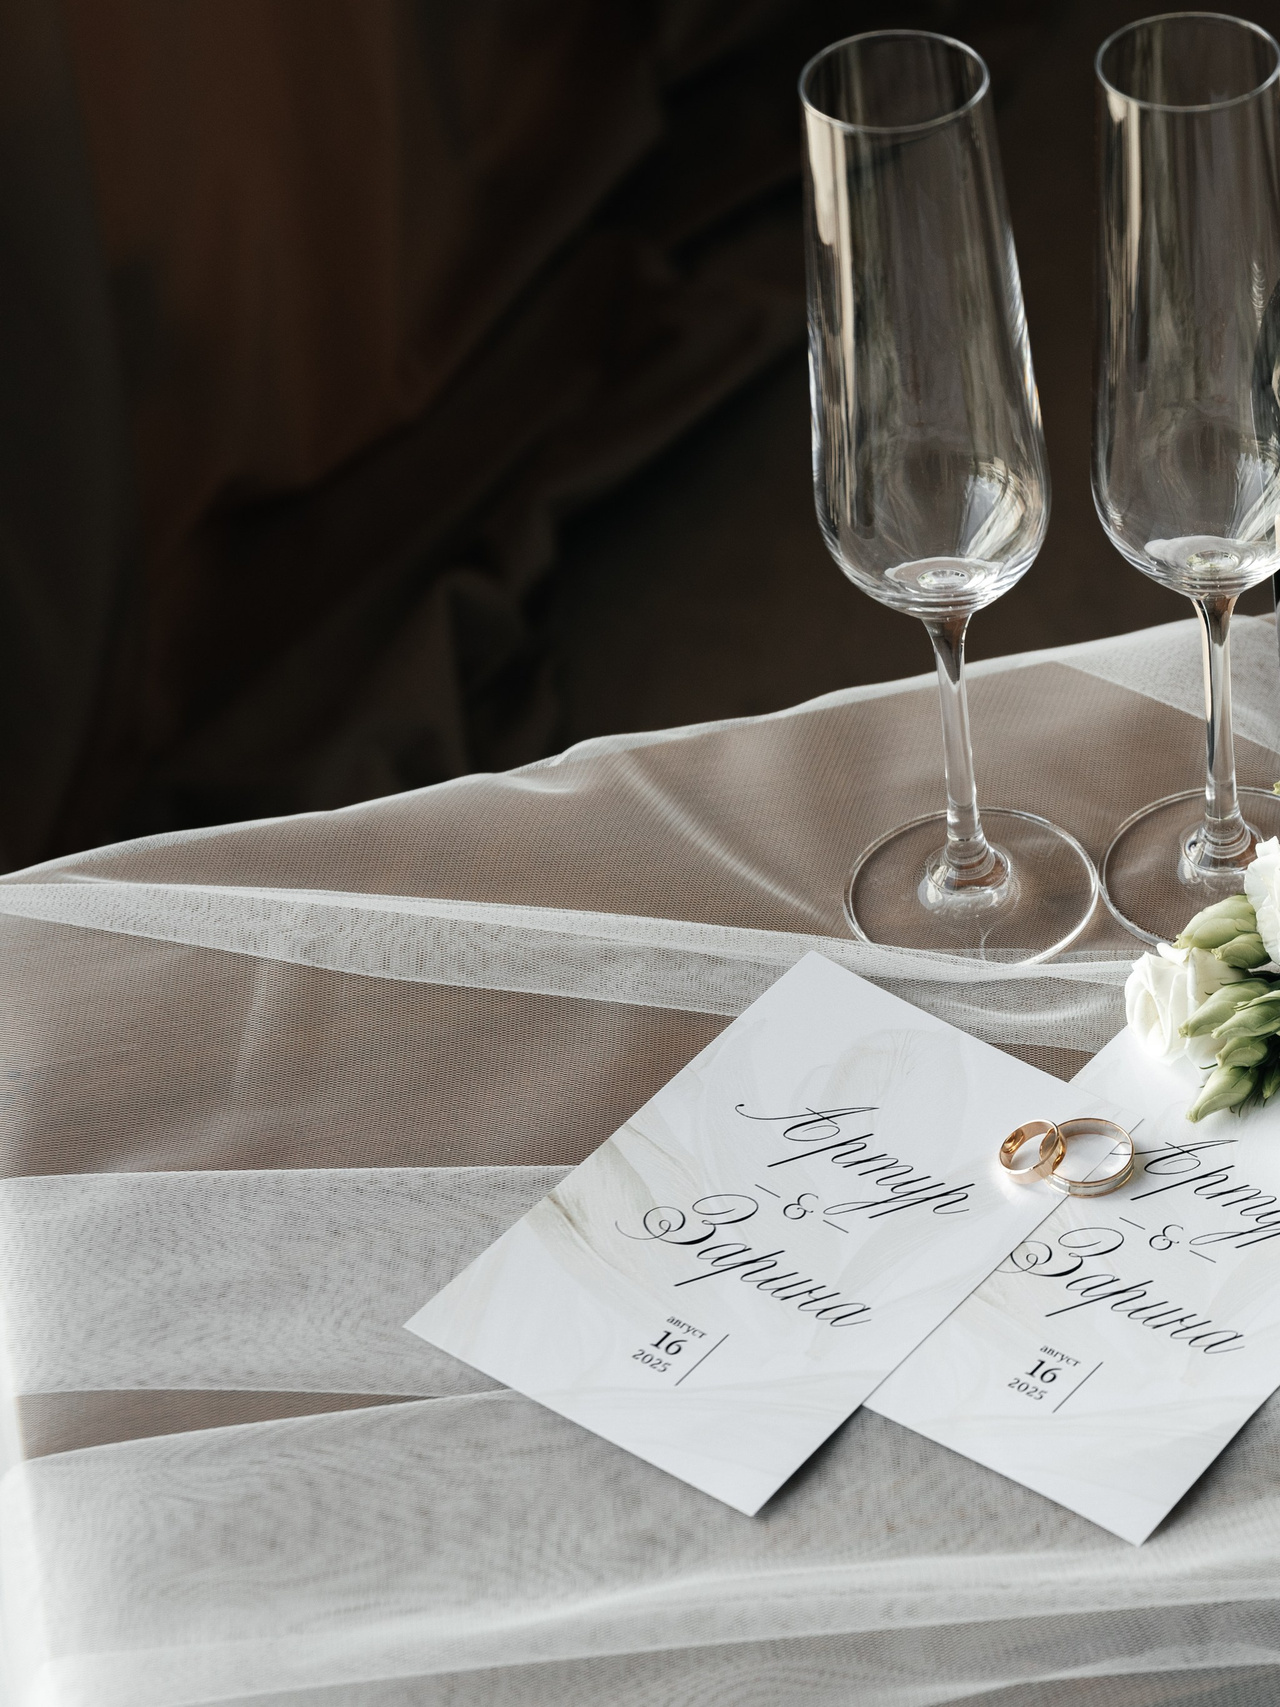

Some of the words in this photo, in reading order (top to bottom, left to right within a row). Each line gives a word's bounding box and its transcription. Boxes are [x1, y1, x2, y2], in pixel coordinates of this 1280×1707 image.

[735, 1103, 975, 1219] Артур
[615, 1193, 872, 1327] Зарина
[995, 1226, 1245, 1354] Зарина
[666, 1316, 707, 1339] август
[650, 1330, 688, 1356] 16
[631, 1348, 672, 1373] 2025
[1039, 1345, 1081, 1367] август
[1025, 1359, 1062, 1384] 16
[1007, 1377, 1048, 1401] 2025
